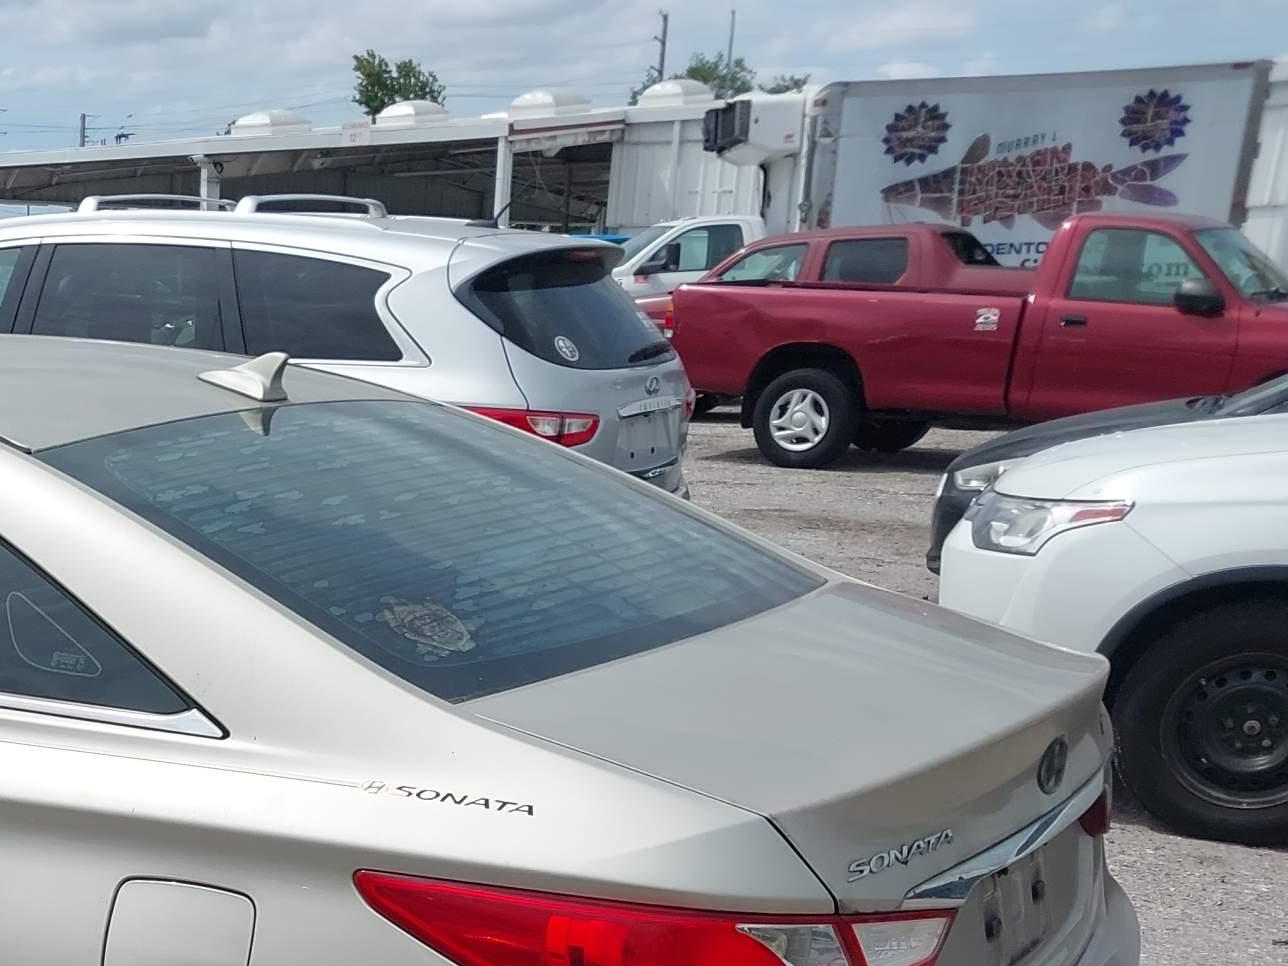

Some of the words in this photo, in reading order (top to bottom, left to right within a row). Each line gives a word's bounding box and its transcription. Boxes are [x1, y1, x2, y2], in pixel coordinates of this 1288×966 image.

[995, 131, 1047, 155] MURRAY
[396, 784, 534, 817] SONATA
[847, 828, 954, 884] SONATA
